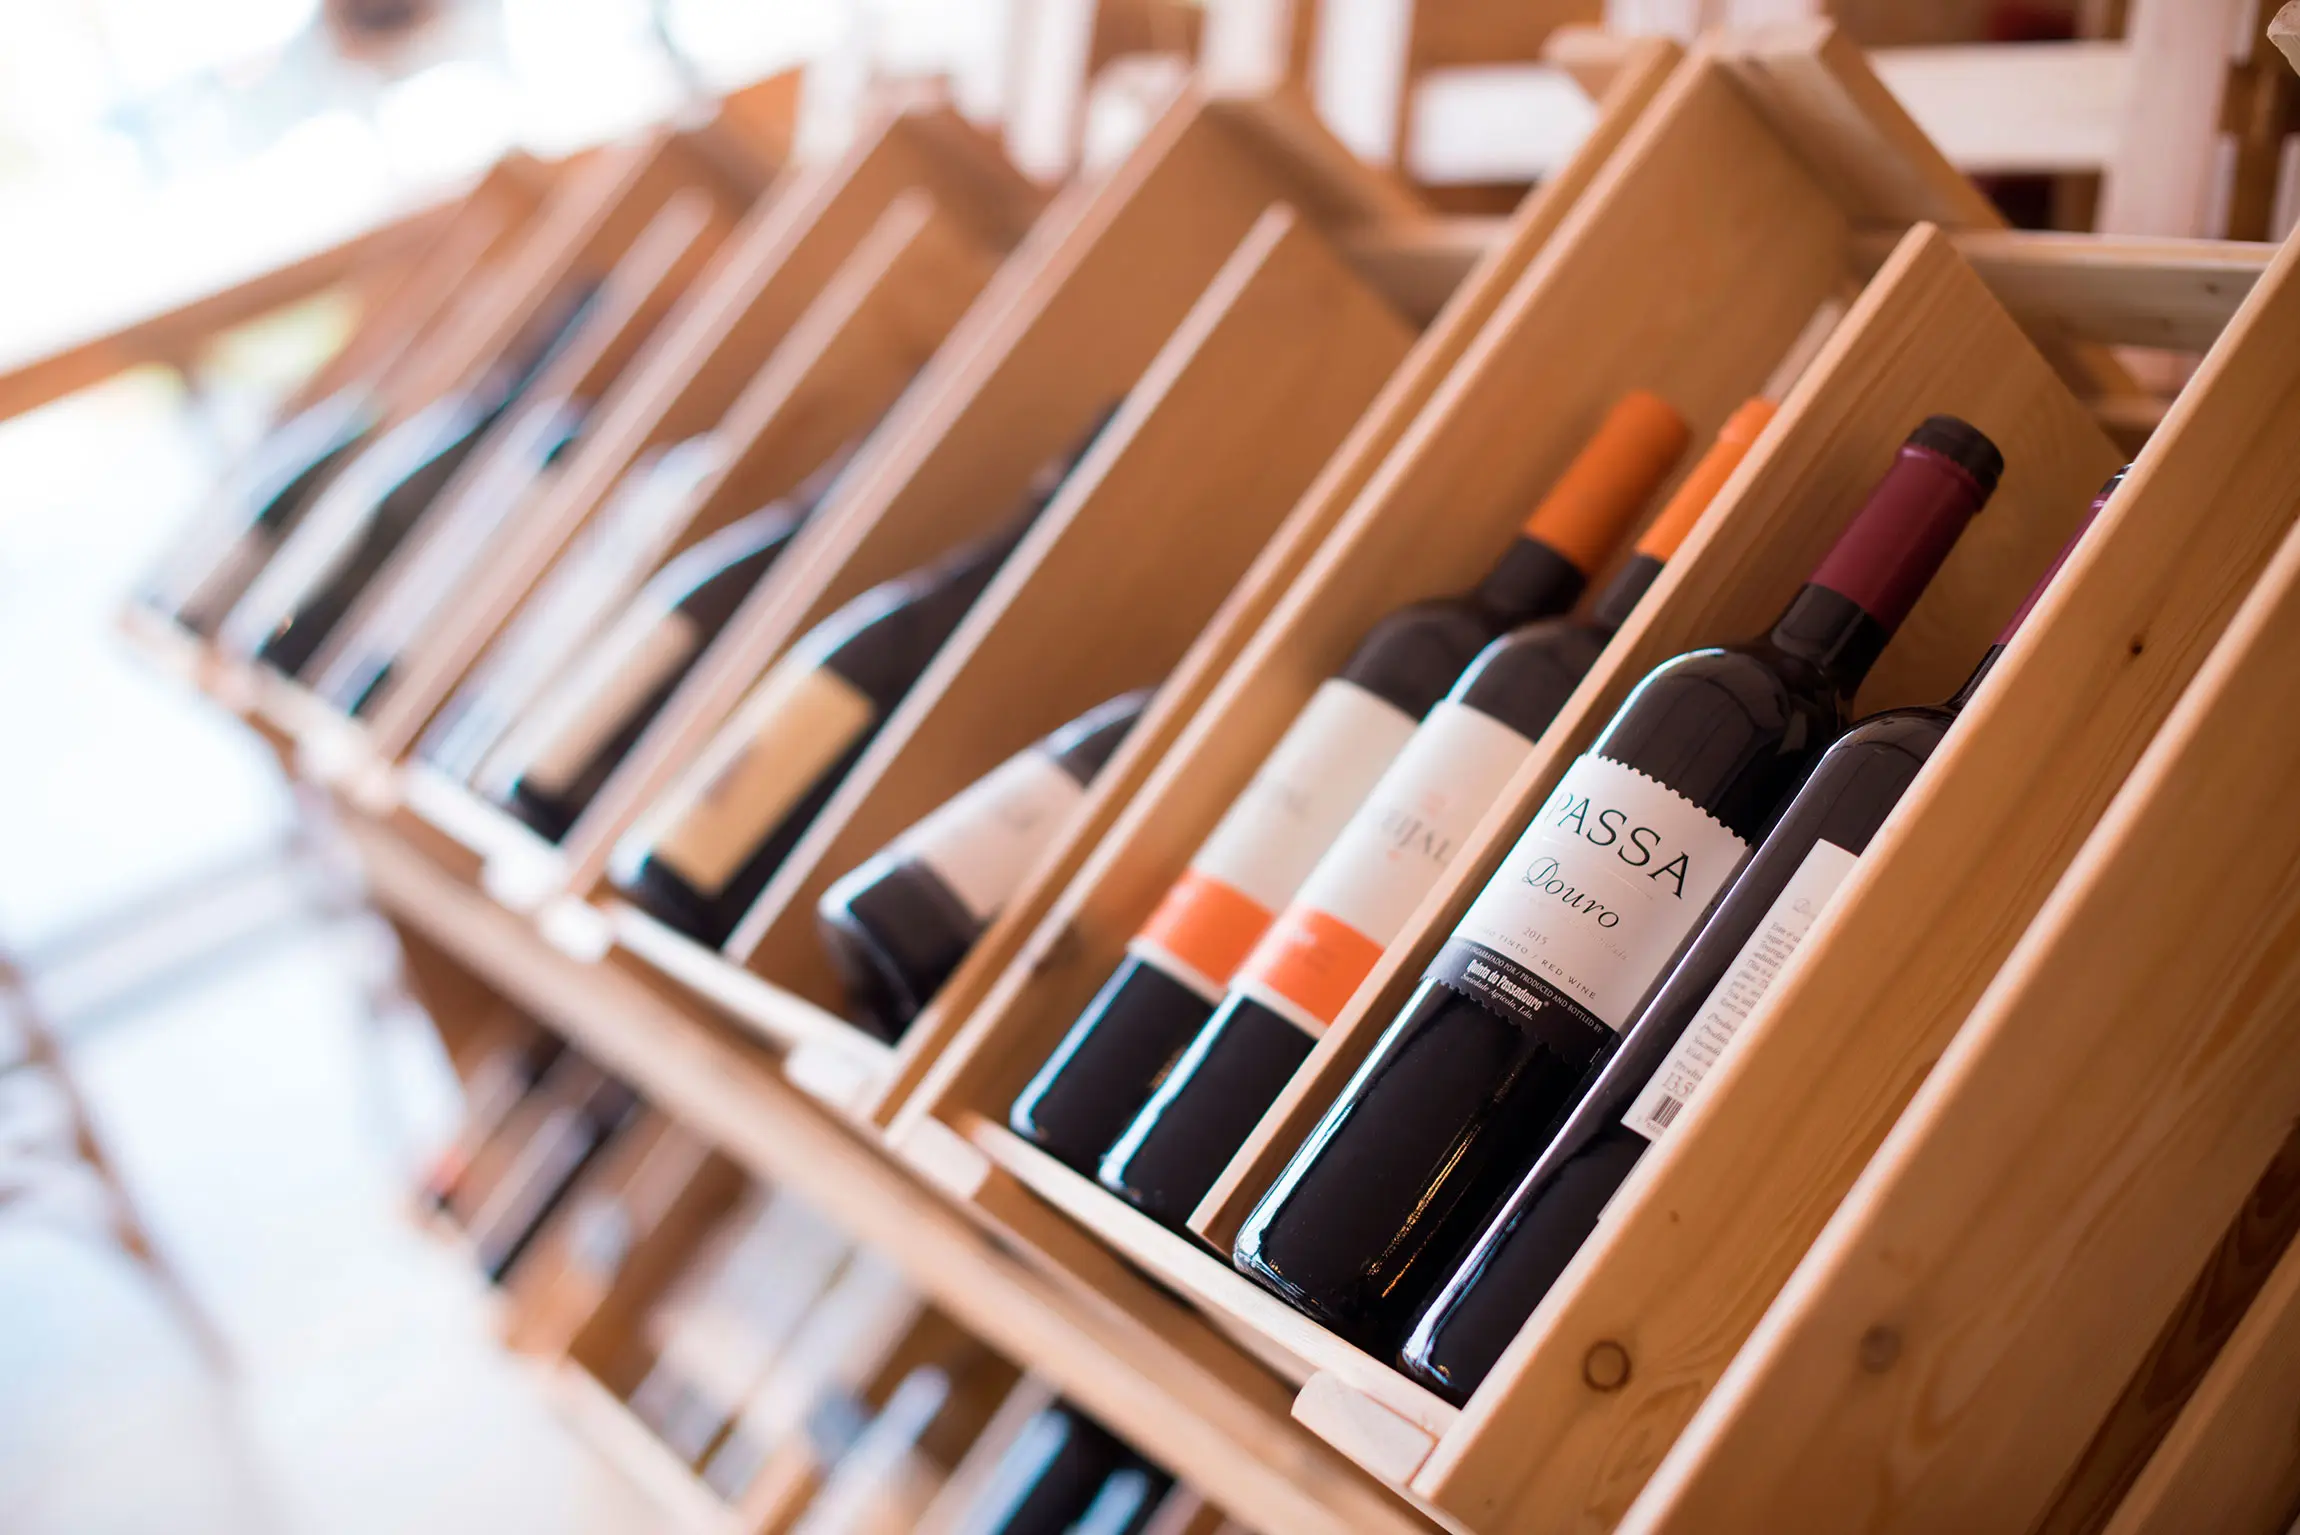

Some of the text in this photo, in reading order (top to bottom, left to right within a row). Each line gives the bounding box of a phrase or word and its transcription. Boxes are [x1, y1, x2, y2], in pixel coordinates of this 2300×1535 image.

[1544, 793, 1690, 900] PASSA
[1522, 857, 1620, 928] Douro
[1499, 934, 1529, 954] TINTO
[1541, 959, 1564, 976] RED
[1568, 976, 1597, 1000] WINE
[1523, 927, 1549, 945] 2015
[1460, 973, 1490, 992] Sociedade
[1466, 959, 1491, 980] Quinta
[1487, 970, 1500, 985] do
[1503, 962, 1516, 975] POR
[1520, 971, 1554, 997] PRODUCED
[1552, 995, 1568, 1008] AND
[1567, 1004, 1595, 1027] BOTTLED
